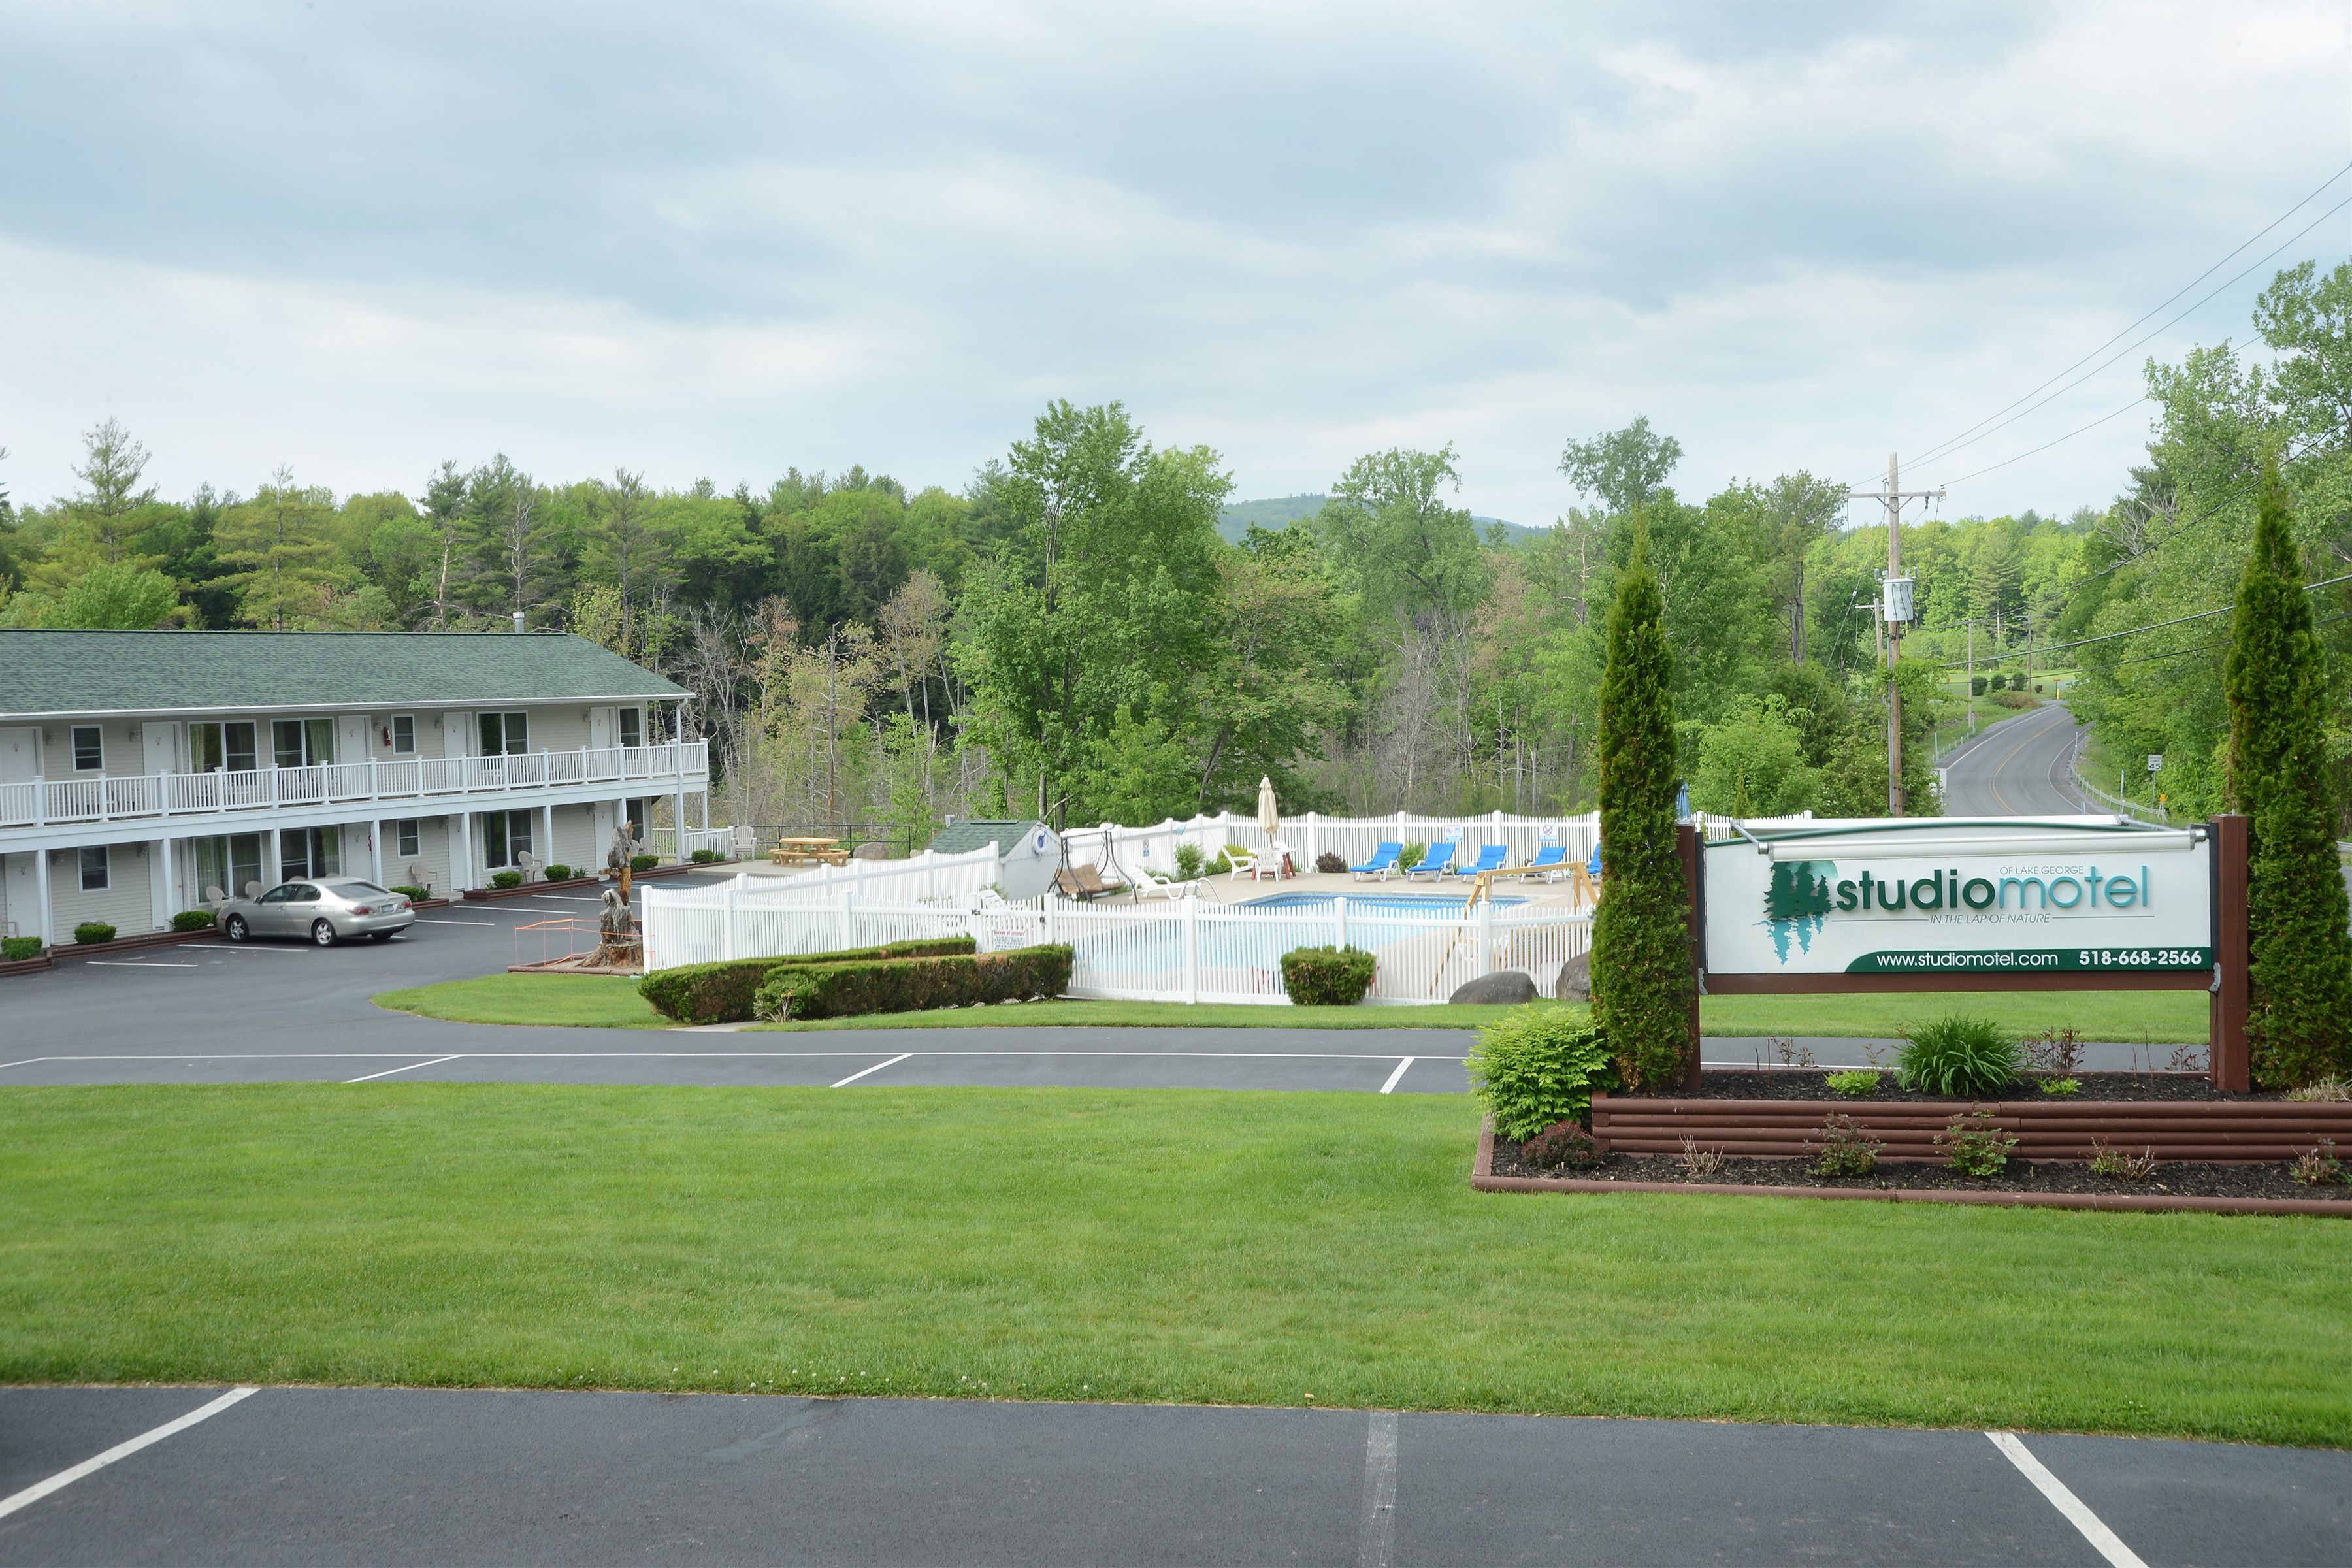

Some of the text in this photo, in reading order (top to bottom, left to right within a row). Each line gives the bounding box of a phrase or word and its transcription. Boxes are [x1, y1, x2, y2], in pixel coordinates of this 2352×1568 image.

[1999, 866, 2084, 874] OF LAKE GEORGE
[1930, 913, 2050, 924] IN THE LAP OF NATURE
[1876, 951, 2202, 966] www.studiomotel.com 518-668-2566
